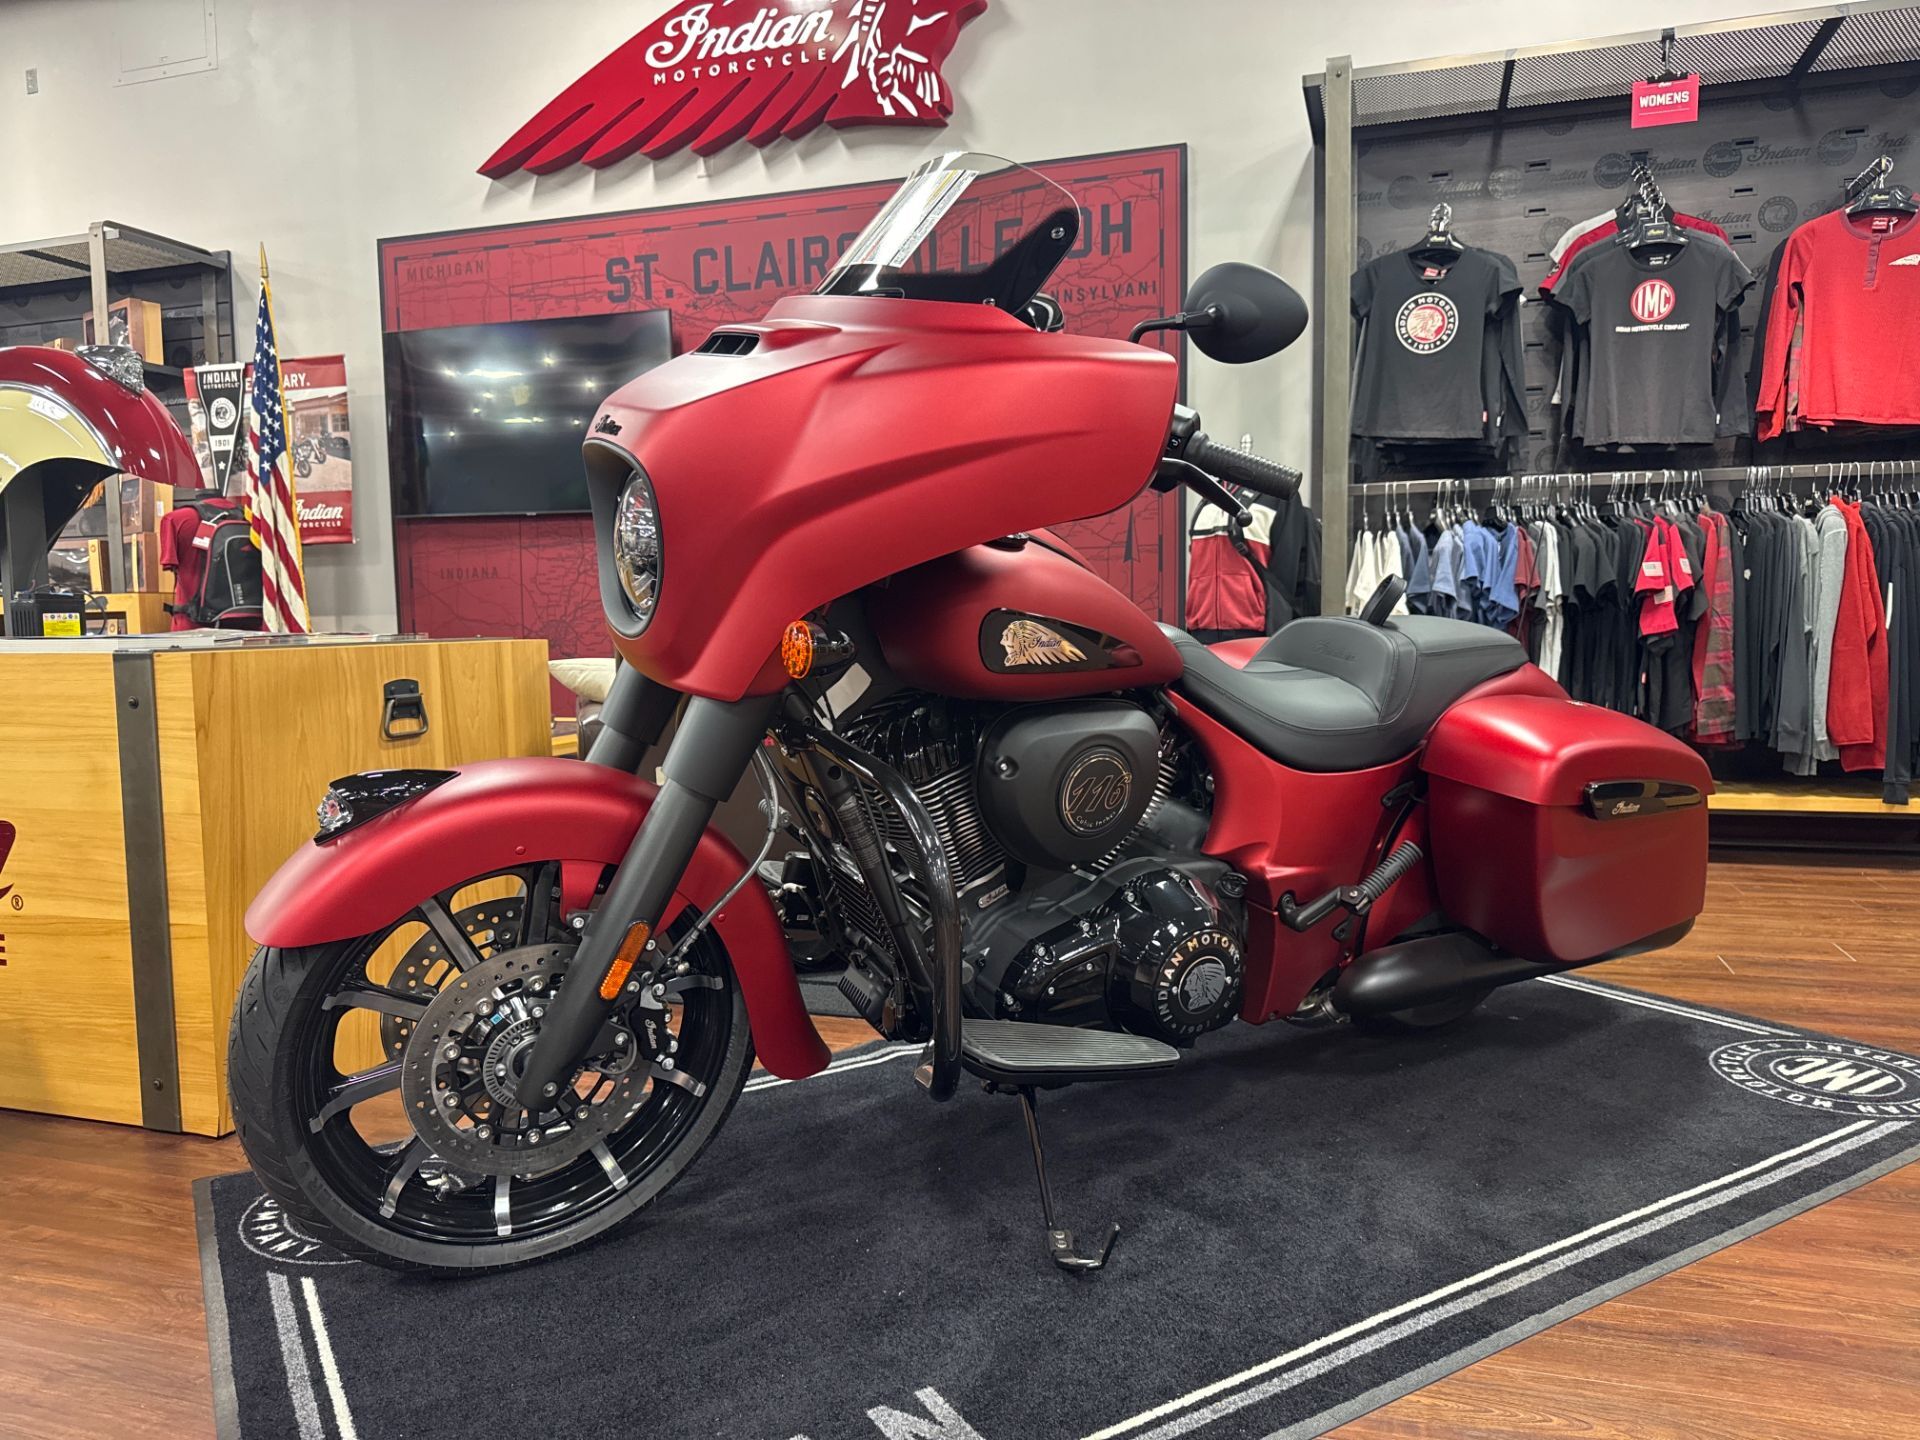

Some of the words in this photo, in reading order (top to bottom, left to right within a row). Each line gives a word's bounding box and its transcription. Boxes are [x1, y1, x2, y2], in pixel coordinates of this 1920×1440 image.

[645, 3, 835, 69] Indian
[653, 48, 827, 86] MOTORCYCLE
[1639, 90, 1690, 108] WOMENS
[406, 259, 485, 283] MICHIGAN
[605, 253, 674, 304] ST.
[1400, 302, 1416, 338] INDIAN
[1417, 296, 1455, 341] MOTORCYCLE
[1637, 284, 1670, 319] IMC
[203, 371, 239, 384] INDIAN
[215, 439, 230, 447] 1901
[440, 566, 499, 580] INDIANA
[1028, 636, 1062, 650] Indian
[1066, 772, 1133, 814] 116
[1611, 800, 1641, 815] Indian
[1157, 952, 1184, 1022] INDIAN
[1718, 1044, 1834, 1109] MOTORCYCLE
[1776, 1056, 1897, 1094] IMC
